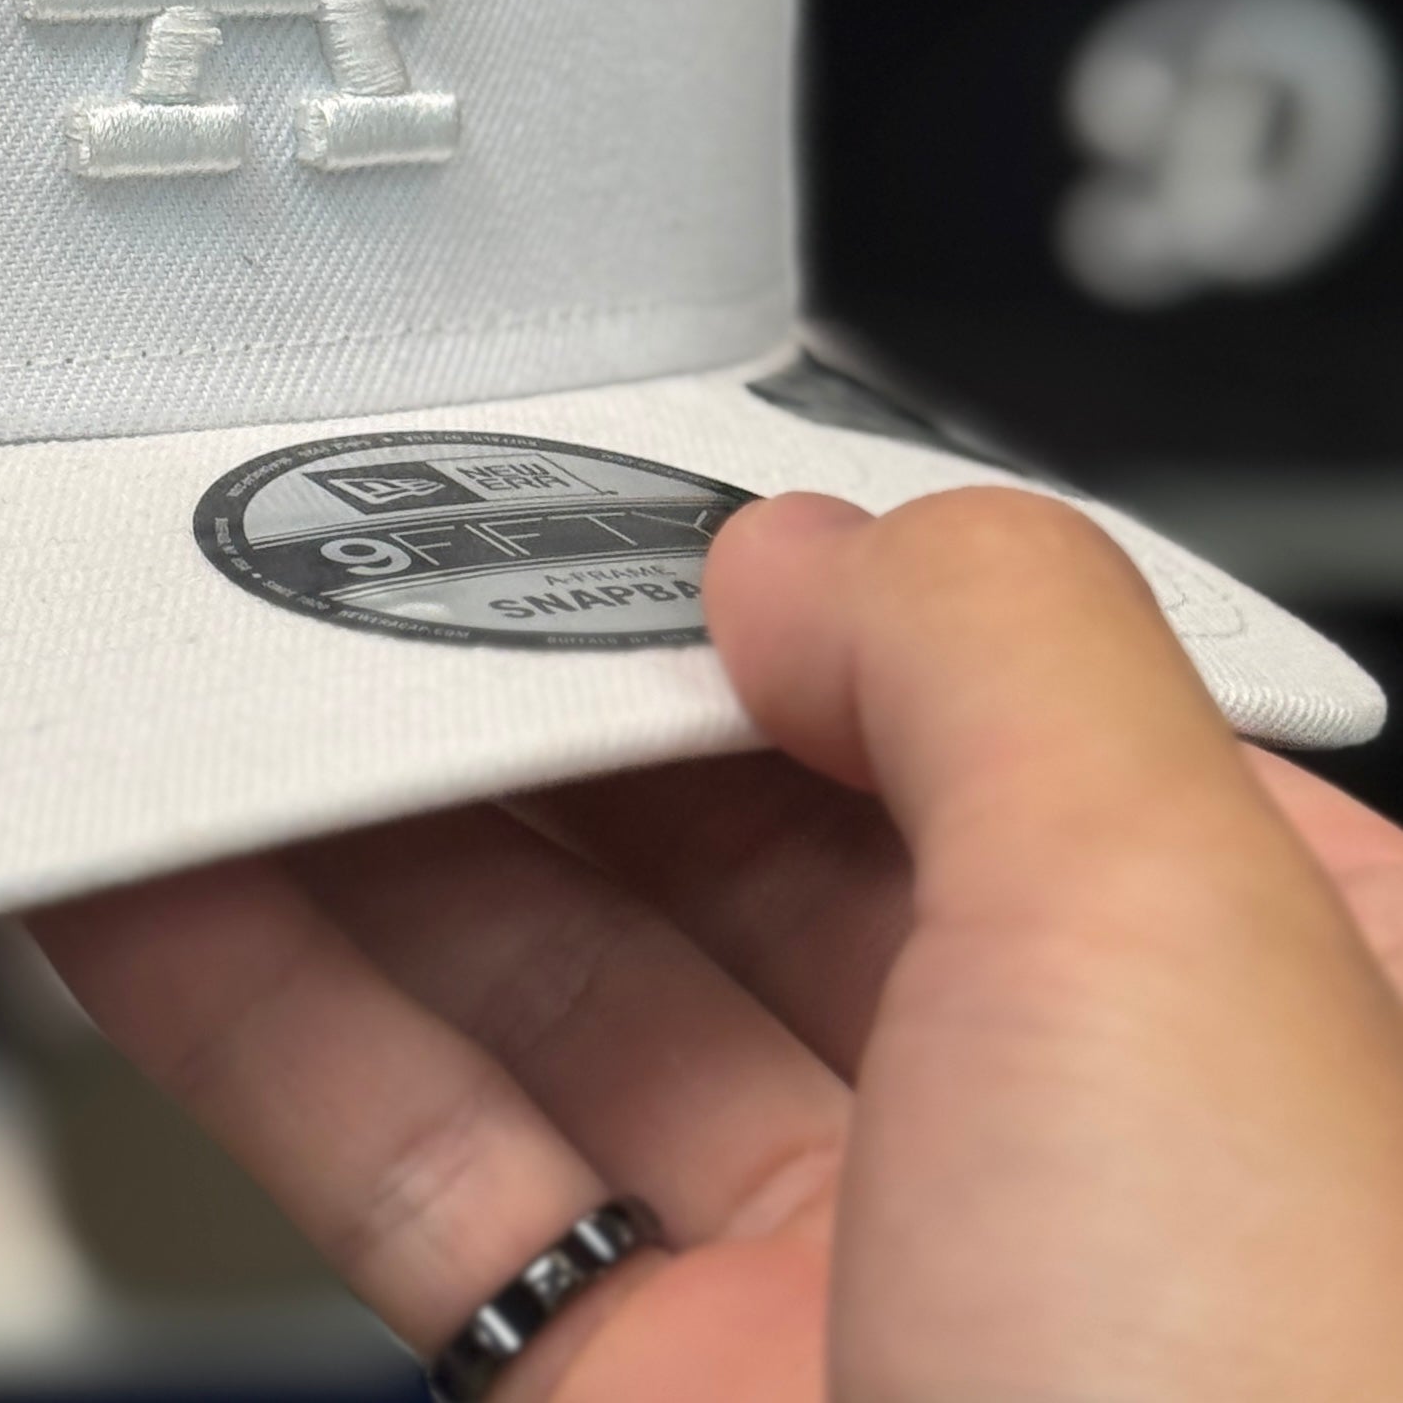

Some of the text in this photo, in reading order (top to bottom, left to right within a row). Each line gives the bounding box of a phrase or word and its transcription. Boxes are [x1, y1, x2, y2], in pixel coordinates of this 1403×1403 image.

[455, 462, 550, 479] NEW
[475, 475, 571, 492] ERA
[319, 509, 714, 577] 9FIFTY
[487, 579, 703, 619] SNAPBA
